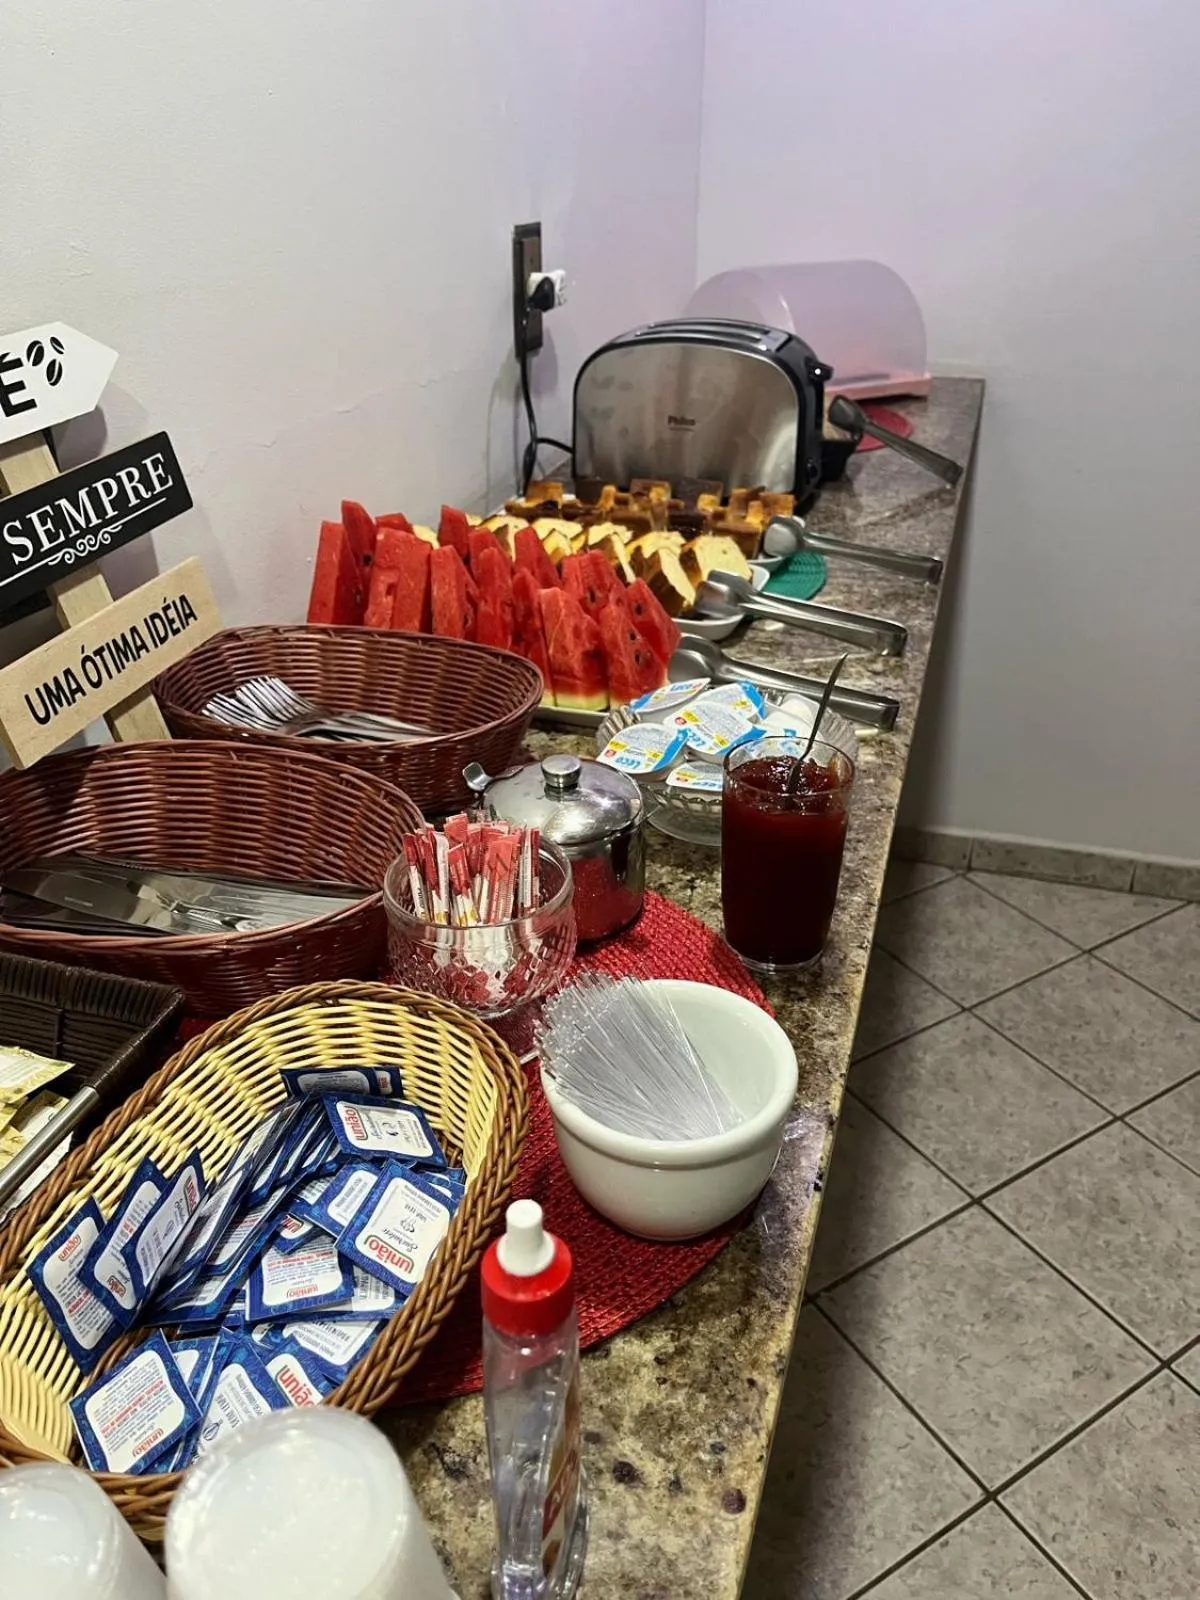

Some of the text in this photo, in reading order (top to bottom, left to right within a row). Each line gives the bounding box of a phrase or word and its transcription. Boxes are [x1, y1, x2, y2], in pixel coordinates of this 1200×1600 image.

[2, 452, 174, 566] SEMPRE
[24, 594, 198, 726] UMA ÓTIMA IDÉIA
[344, 1109, 366, 1140] união
[368, 1239, 412, 1272] união
